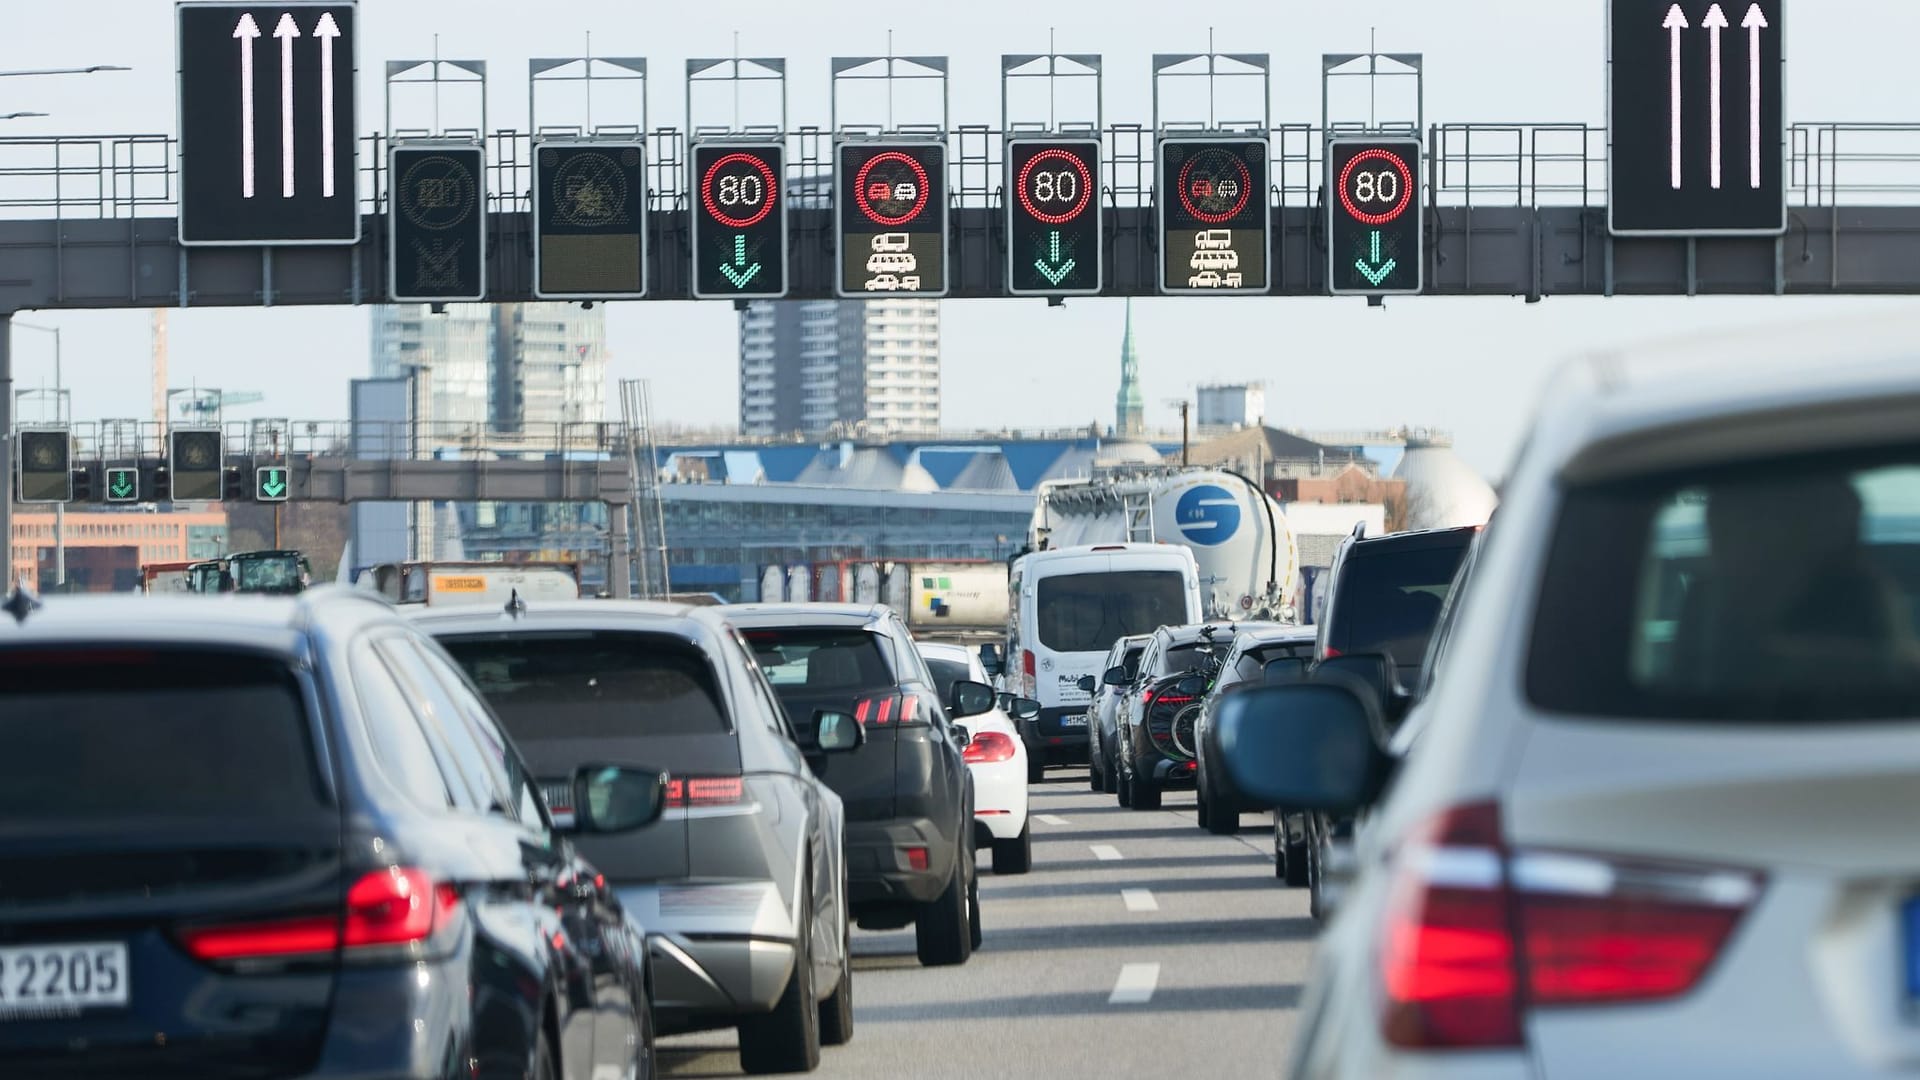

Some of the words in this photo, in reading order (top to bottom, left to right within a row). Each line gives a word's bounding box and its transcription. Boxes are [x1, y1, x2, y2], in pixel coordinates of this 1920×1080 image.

[718, 174, 761, 206] 80
[1035, 171, 1076, 202] 80
[1355, 170, 1397, 203] 80
[15, 950, 119, 998] 2205
